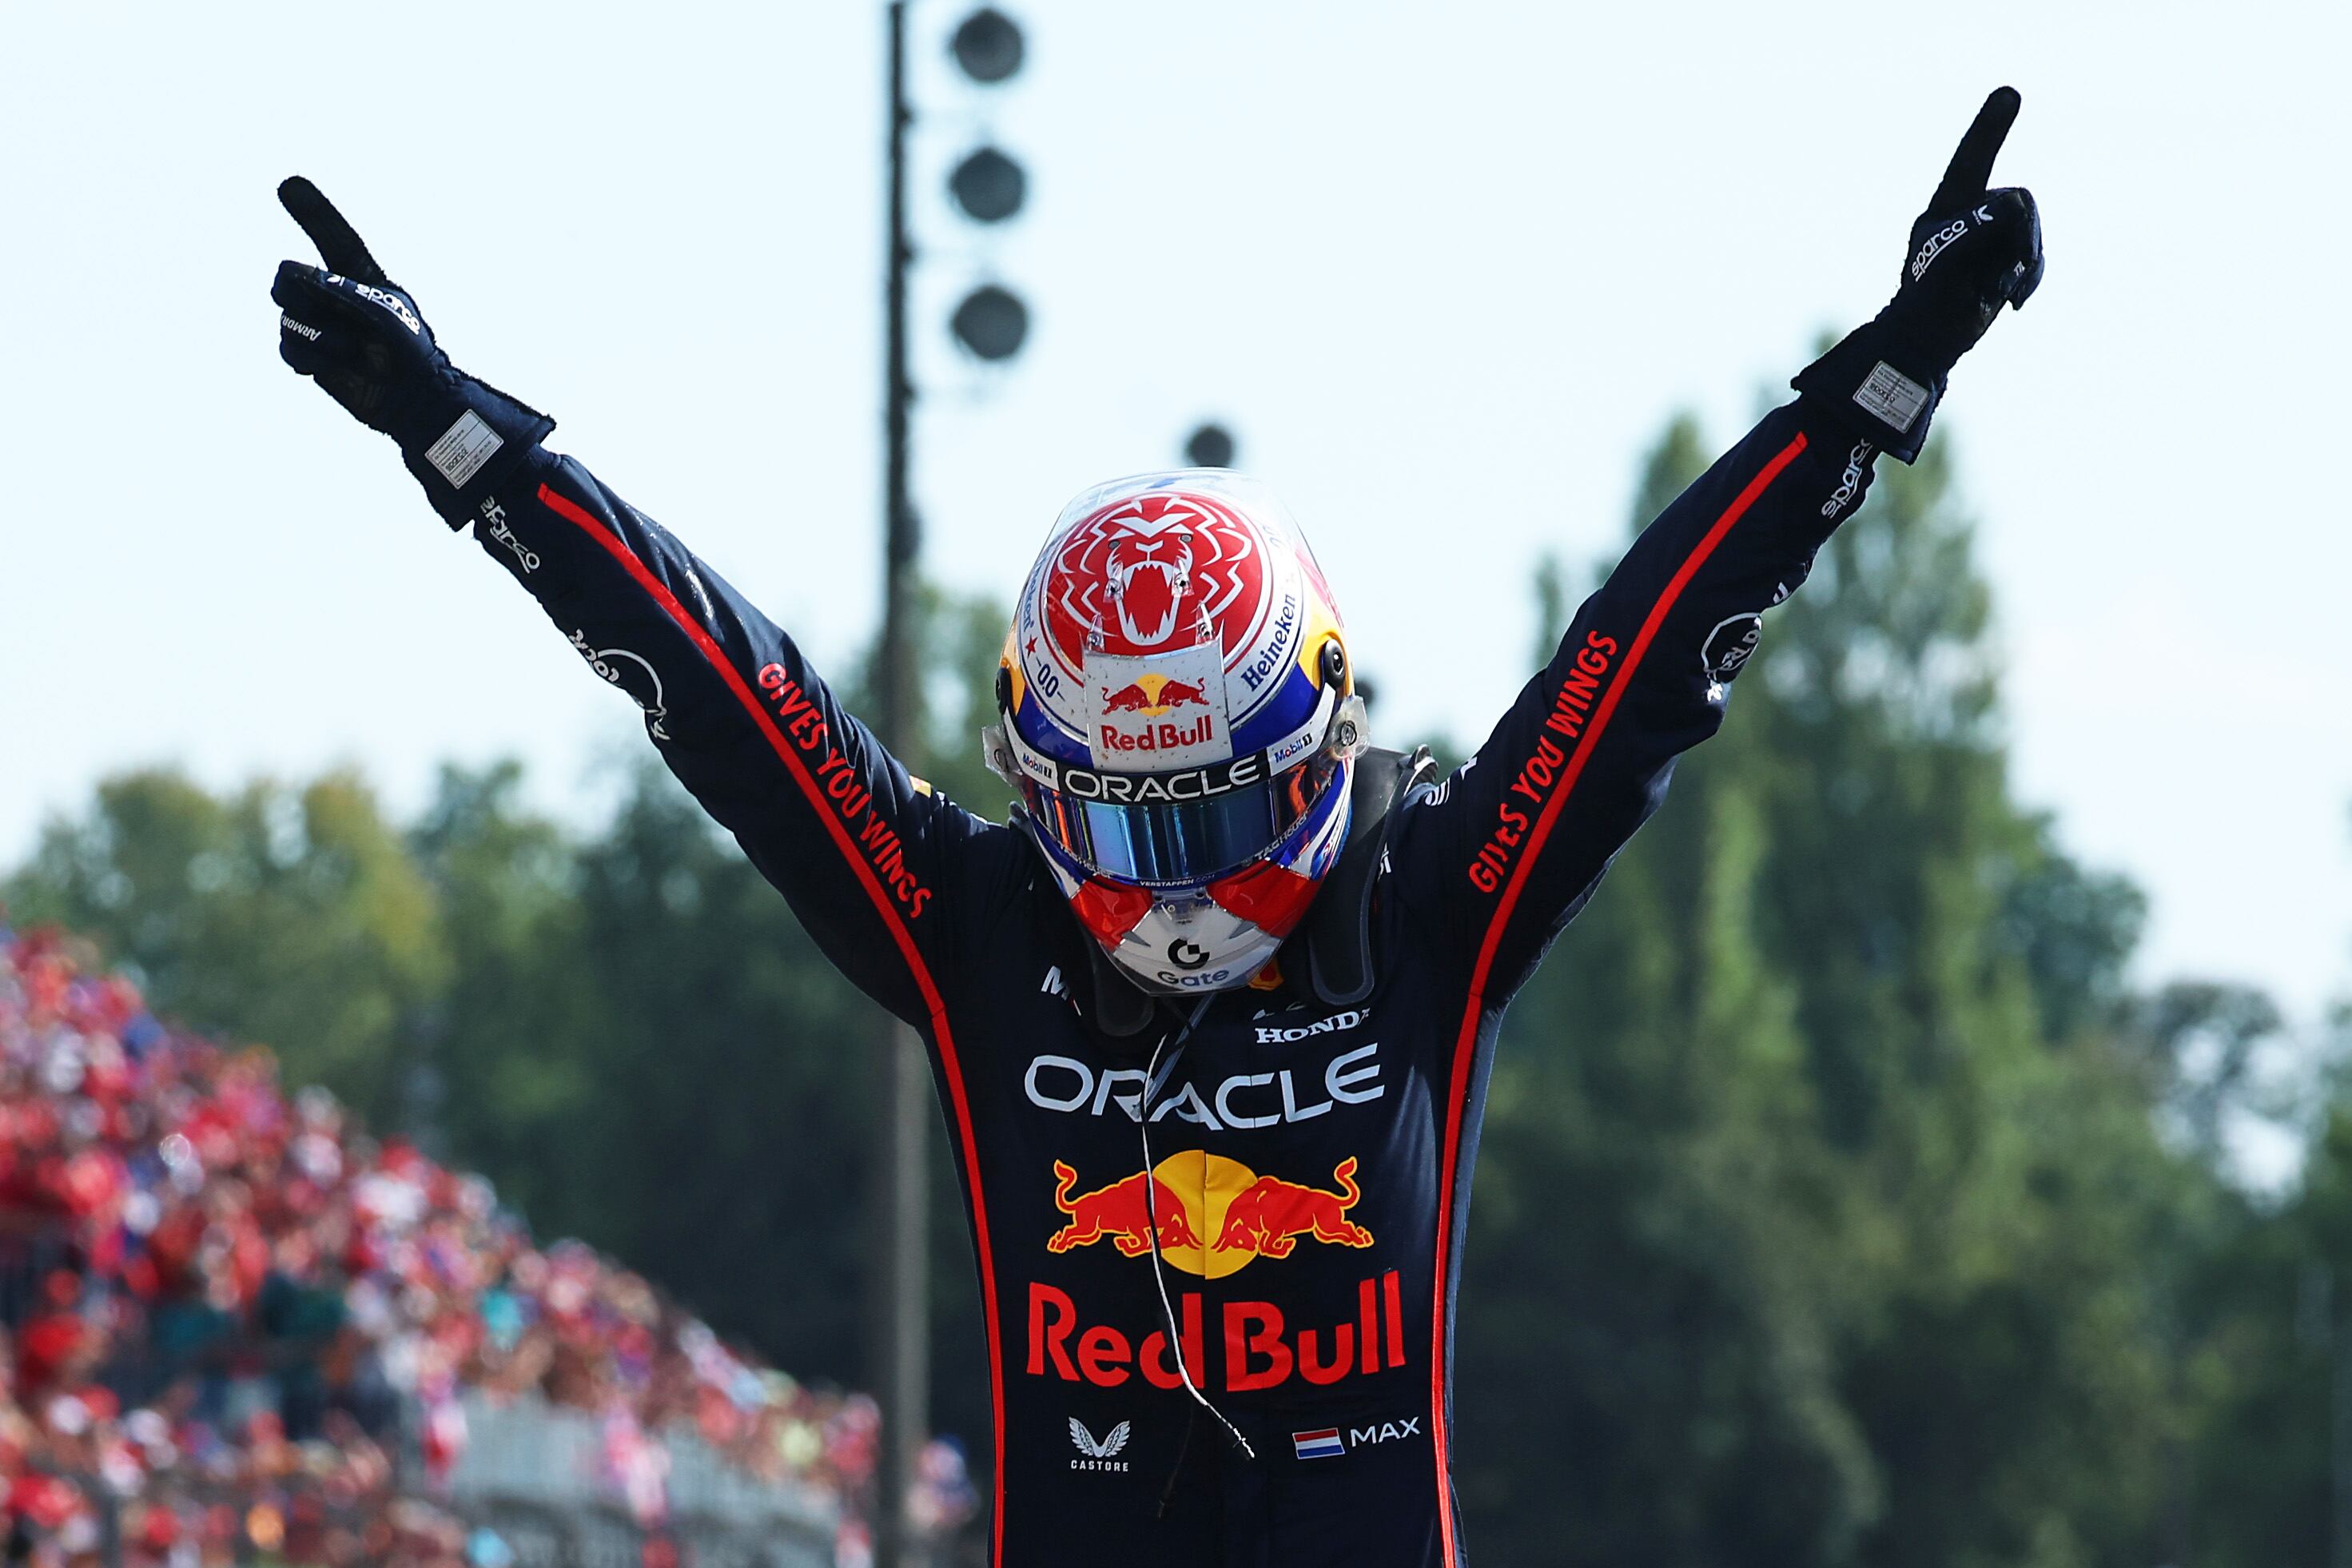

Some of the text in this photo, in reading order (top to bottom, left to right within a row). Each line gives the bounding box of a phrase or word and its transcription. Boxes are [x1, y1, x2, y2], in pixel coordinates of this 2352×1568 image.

[1912, 220, 1966, 278] sparco
[280, 315, 321, 341] ARMOR
[356, 283, 421, 333] sparco
[1240, 594, 1296, 692] Heineken
[1100, 714, 1213, 751] Red Bull
[1274, 738, 1303, 763] Mobil
[1065, 754, 1260, 802] ORACLE
[1469, 630, 1618, 893] GIVES YOU WINGS
[758, 663, 932, 918] GIVES YOU WINGS
[1157, 969, 1229, 986] Gate
[1025, 1042, 1385, 1131] ORACLE
[1026, 1270, 1406, 1391] Red Bull
[1351, 1416, 1421, 1447] MAX
[1071, 1459, 1129, 1472] CASTORE
